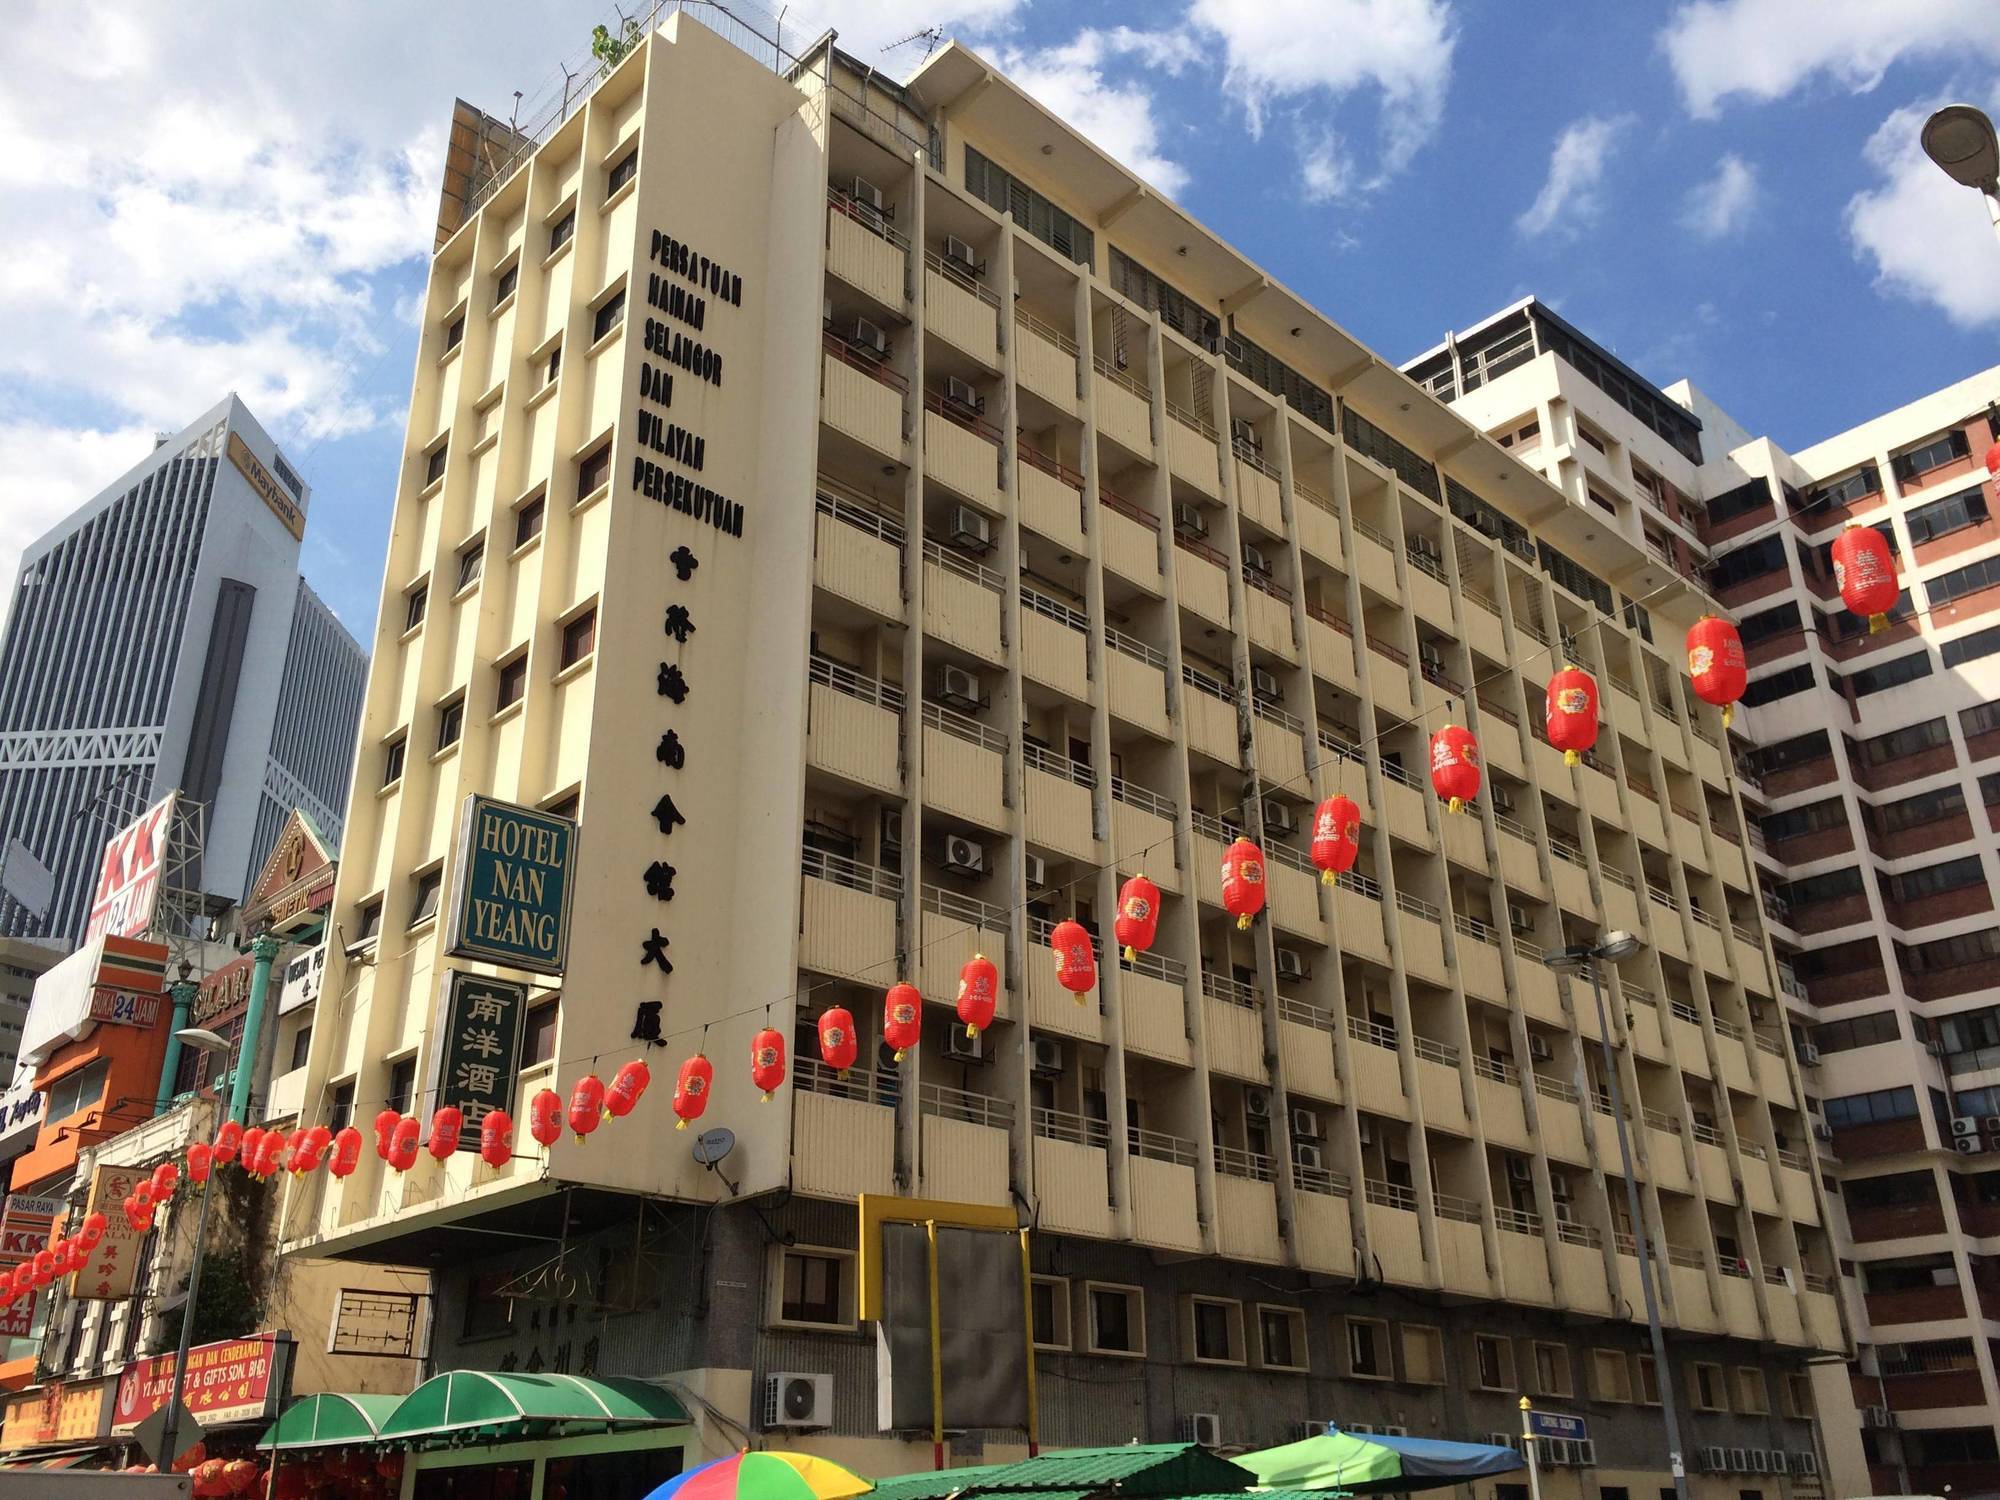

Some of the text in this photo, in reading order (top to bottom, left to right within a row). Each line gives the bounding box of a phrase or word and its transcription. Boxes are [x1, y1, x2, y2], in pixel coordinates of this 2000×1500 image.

[650, 229, 742, 308] PERSATUAN
[648, 272, 706, 332] HAINAN
[644, 317, 723, 388] SELANGOR
[639, 362, 674, 409] DAN
[250, 462, 296, 525] Maybank
[632, 456, 744, 539] PERSEKUTUAN
[98, 805, 166, 902] KK
[481, 814, 562, 868] HOTEL
[492, 860, 546, 907] NAN
[474, 898, 555, 952] YEANG
[92, 992, 158, 1023] BUKA 24 JAM
[456, 992, 511, 1130] 南洋酒店
[12, 1198, 54, 1214] PASAR RAYA
[3, 1232, 46, 1253] KK
[142, 1382, 152, 1398] YI
[153, 1379, 166, 1396] XIN
[193, 1371, 201, 1388] &
[204, 1365, 226, 1386] GIFTS
[228, 1362, 246, 1382] SDN.
[248, 1358, 266, 1379] BHD.
[205, 1349, 219, 1366] DAN
